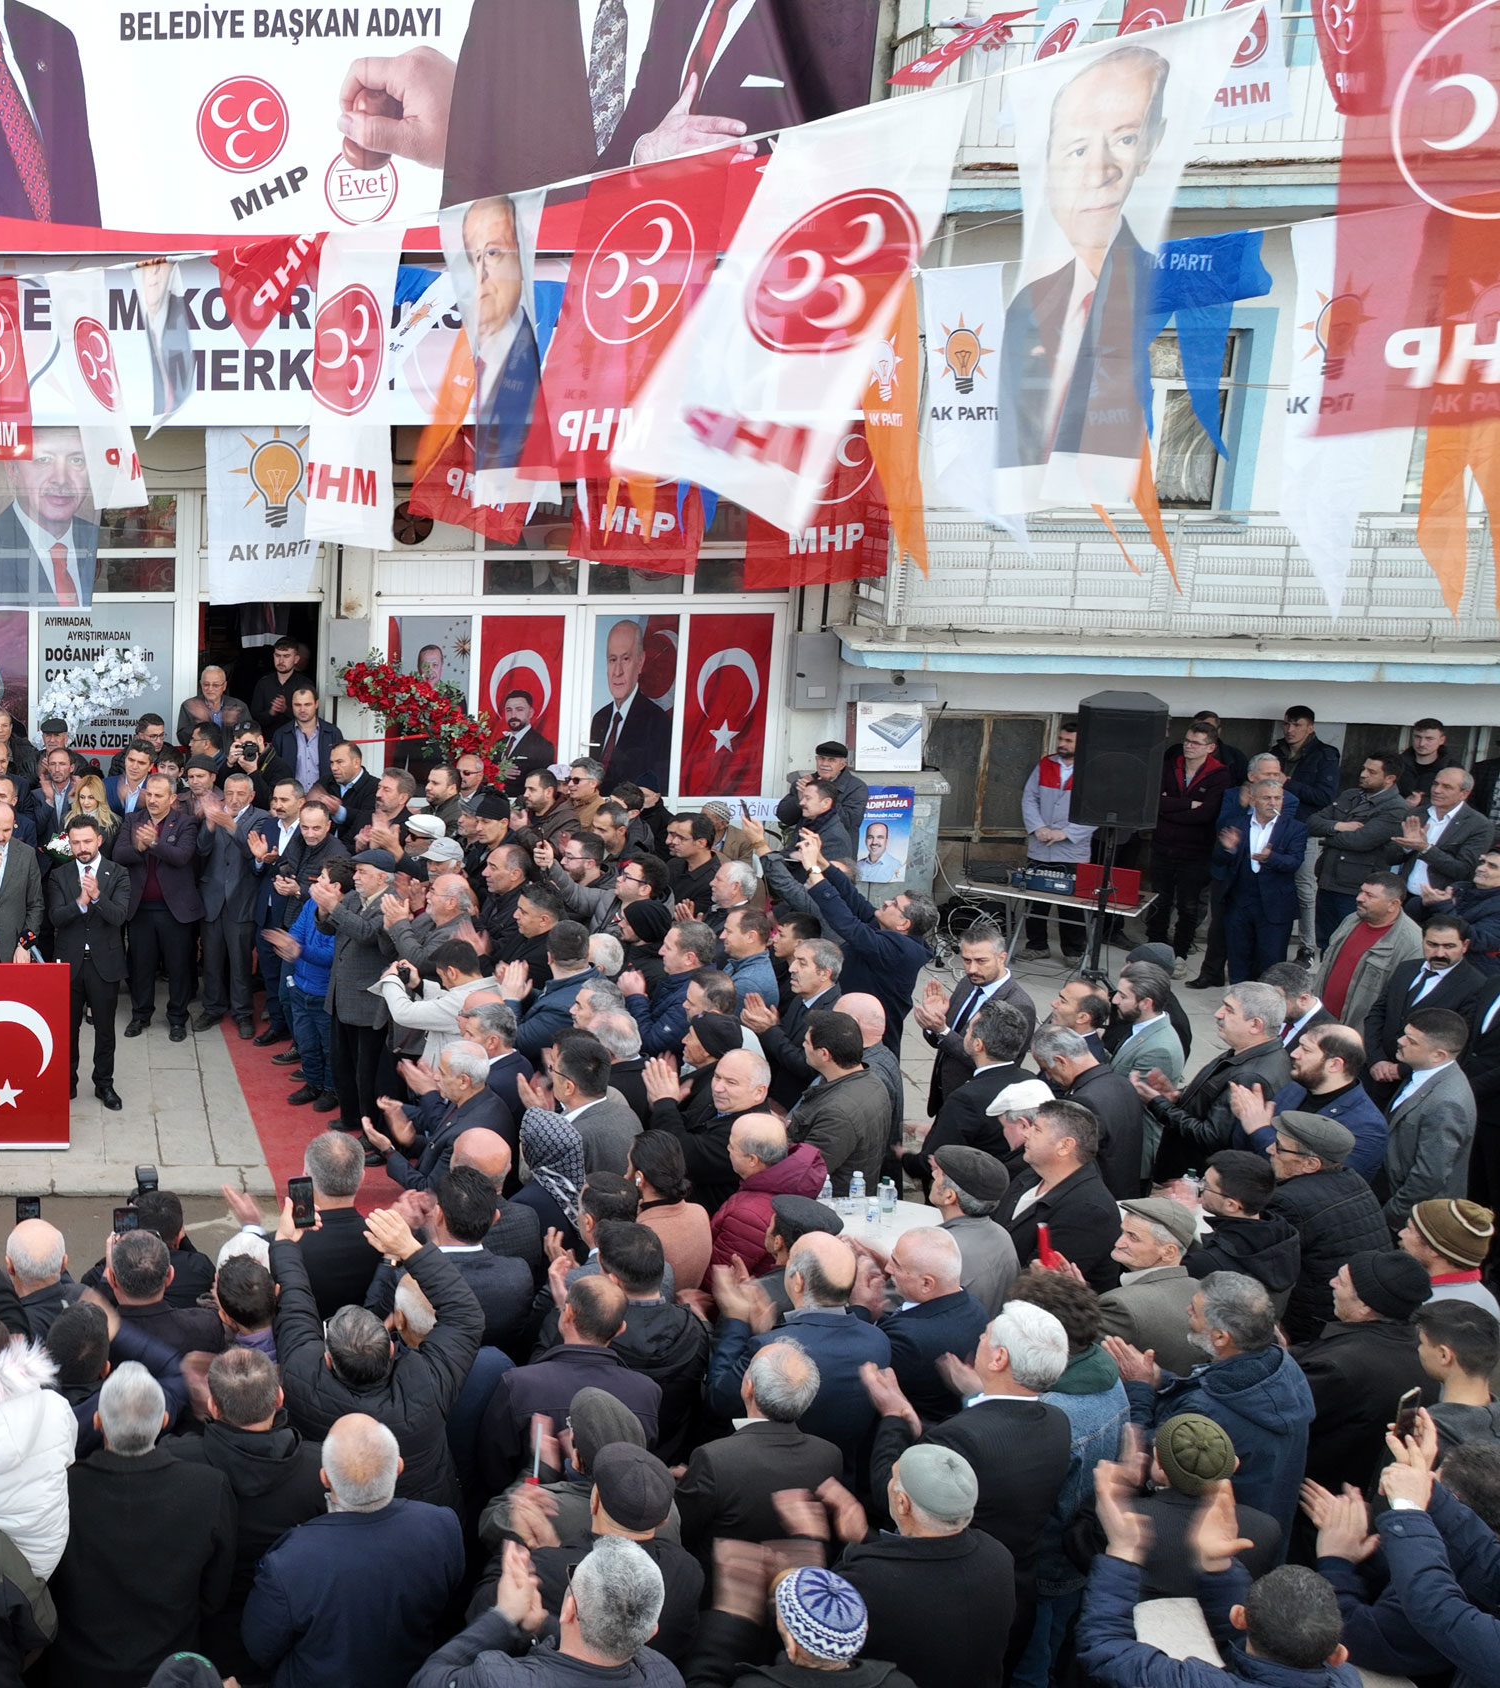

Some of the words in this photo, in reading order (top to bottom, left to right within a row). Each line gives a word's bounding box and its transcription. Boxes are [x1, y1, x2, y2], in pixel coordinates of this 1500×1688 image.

[120, 3, 245, 40] BELEDİYE
[254, 8, 359, 45] BAŞKAN
[366, 8, 442, 37] ADAYI
[230, 165, 309, 221] MHP
[338, 172, 388, 197] Evet
[931, 406, 953, 421] AK
[788, 522, 865, 555] MHP
[228, 543, 259, 562] AK
[67, 631, 131, 642] AYRIŞTIRMADAN
[45, 645, 130, 662] DOĞANHİ
[70, 733, 97, 749] AVAŞ
[885, 799, 908, 808] DAHA
